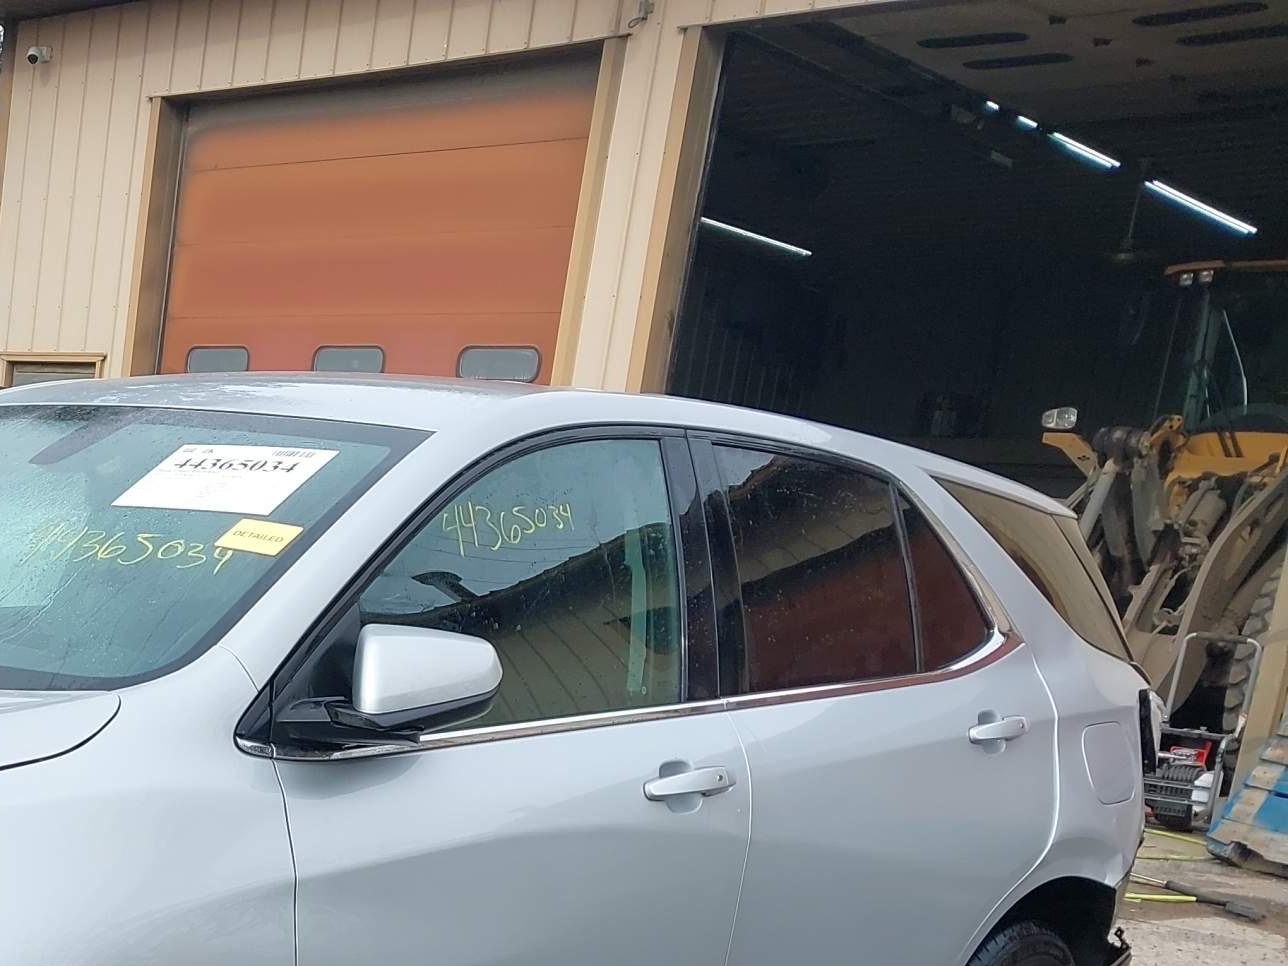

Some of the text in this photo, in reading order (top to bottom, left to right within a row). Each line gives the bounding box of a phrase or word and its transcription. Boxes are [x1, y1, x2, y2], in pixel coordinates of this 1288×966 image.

[174, 457, 300, 473] 44365034
[233, 530, 284, 543] DETAILED
[443, 501, 575, 557] 44365034
[20, 522, 233, 575] 44365034
